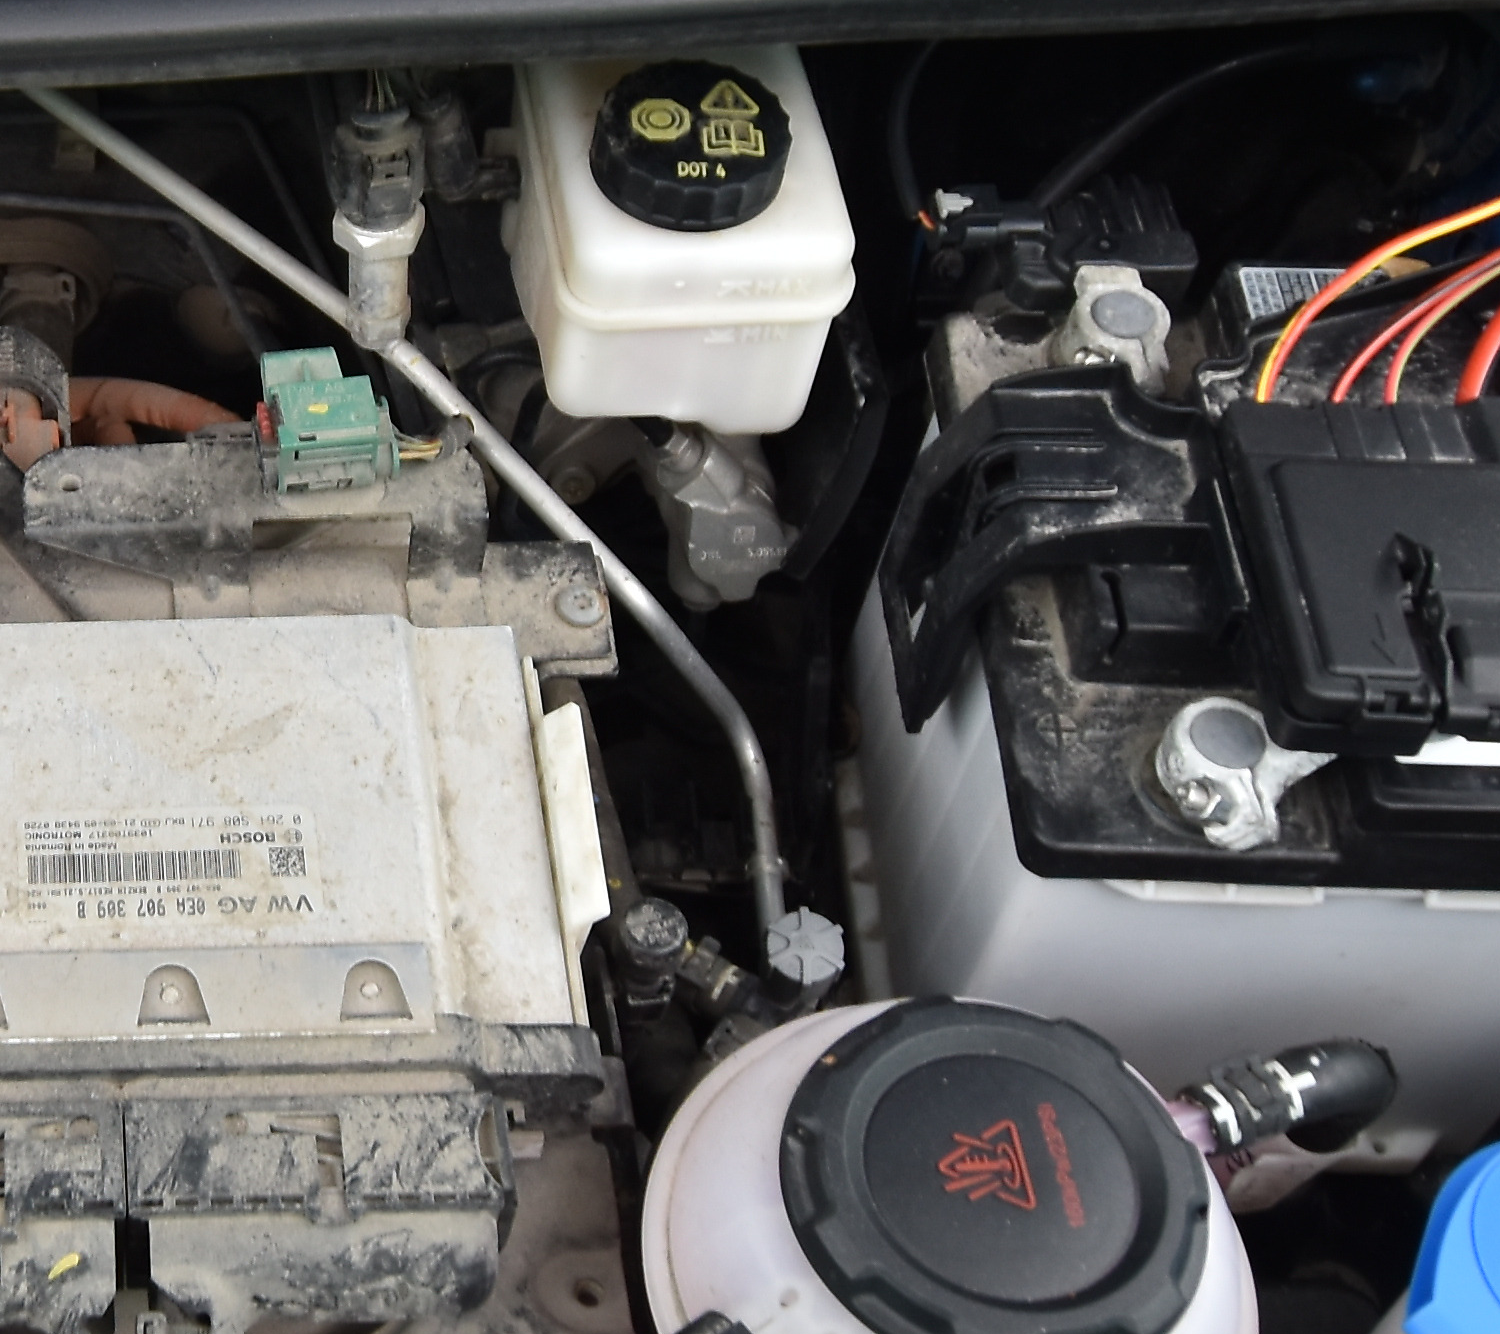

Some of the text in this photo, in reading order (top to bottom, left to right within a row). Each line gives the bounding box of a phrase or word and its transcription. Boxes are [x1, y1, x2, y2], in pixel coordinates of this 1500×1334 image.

[677, 161, 726, 179] DOT 4
[25, 831, 82, 840] MOTRONIC
[220, 832, 276, 843] BOSCH
[25, 842, 117, 852] Made in Romania
[77, 900, 86, 919] B
[97, 900, 126, 918] 309
[137, 898, 166, 917] 907
[218, 896, 257, 914] AG
[268, 895, 314, 913] VW
